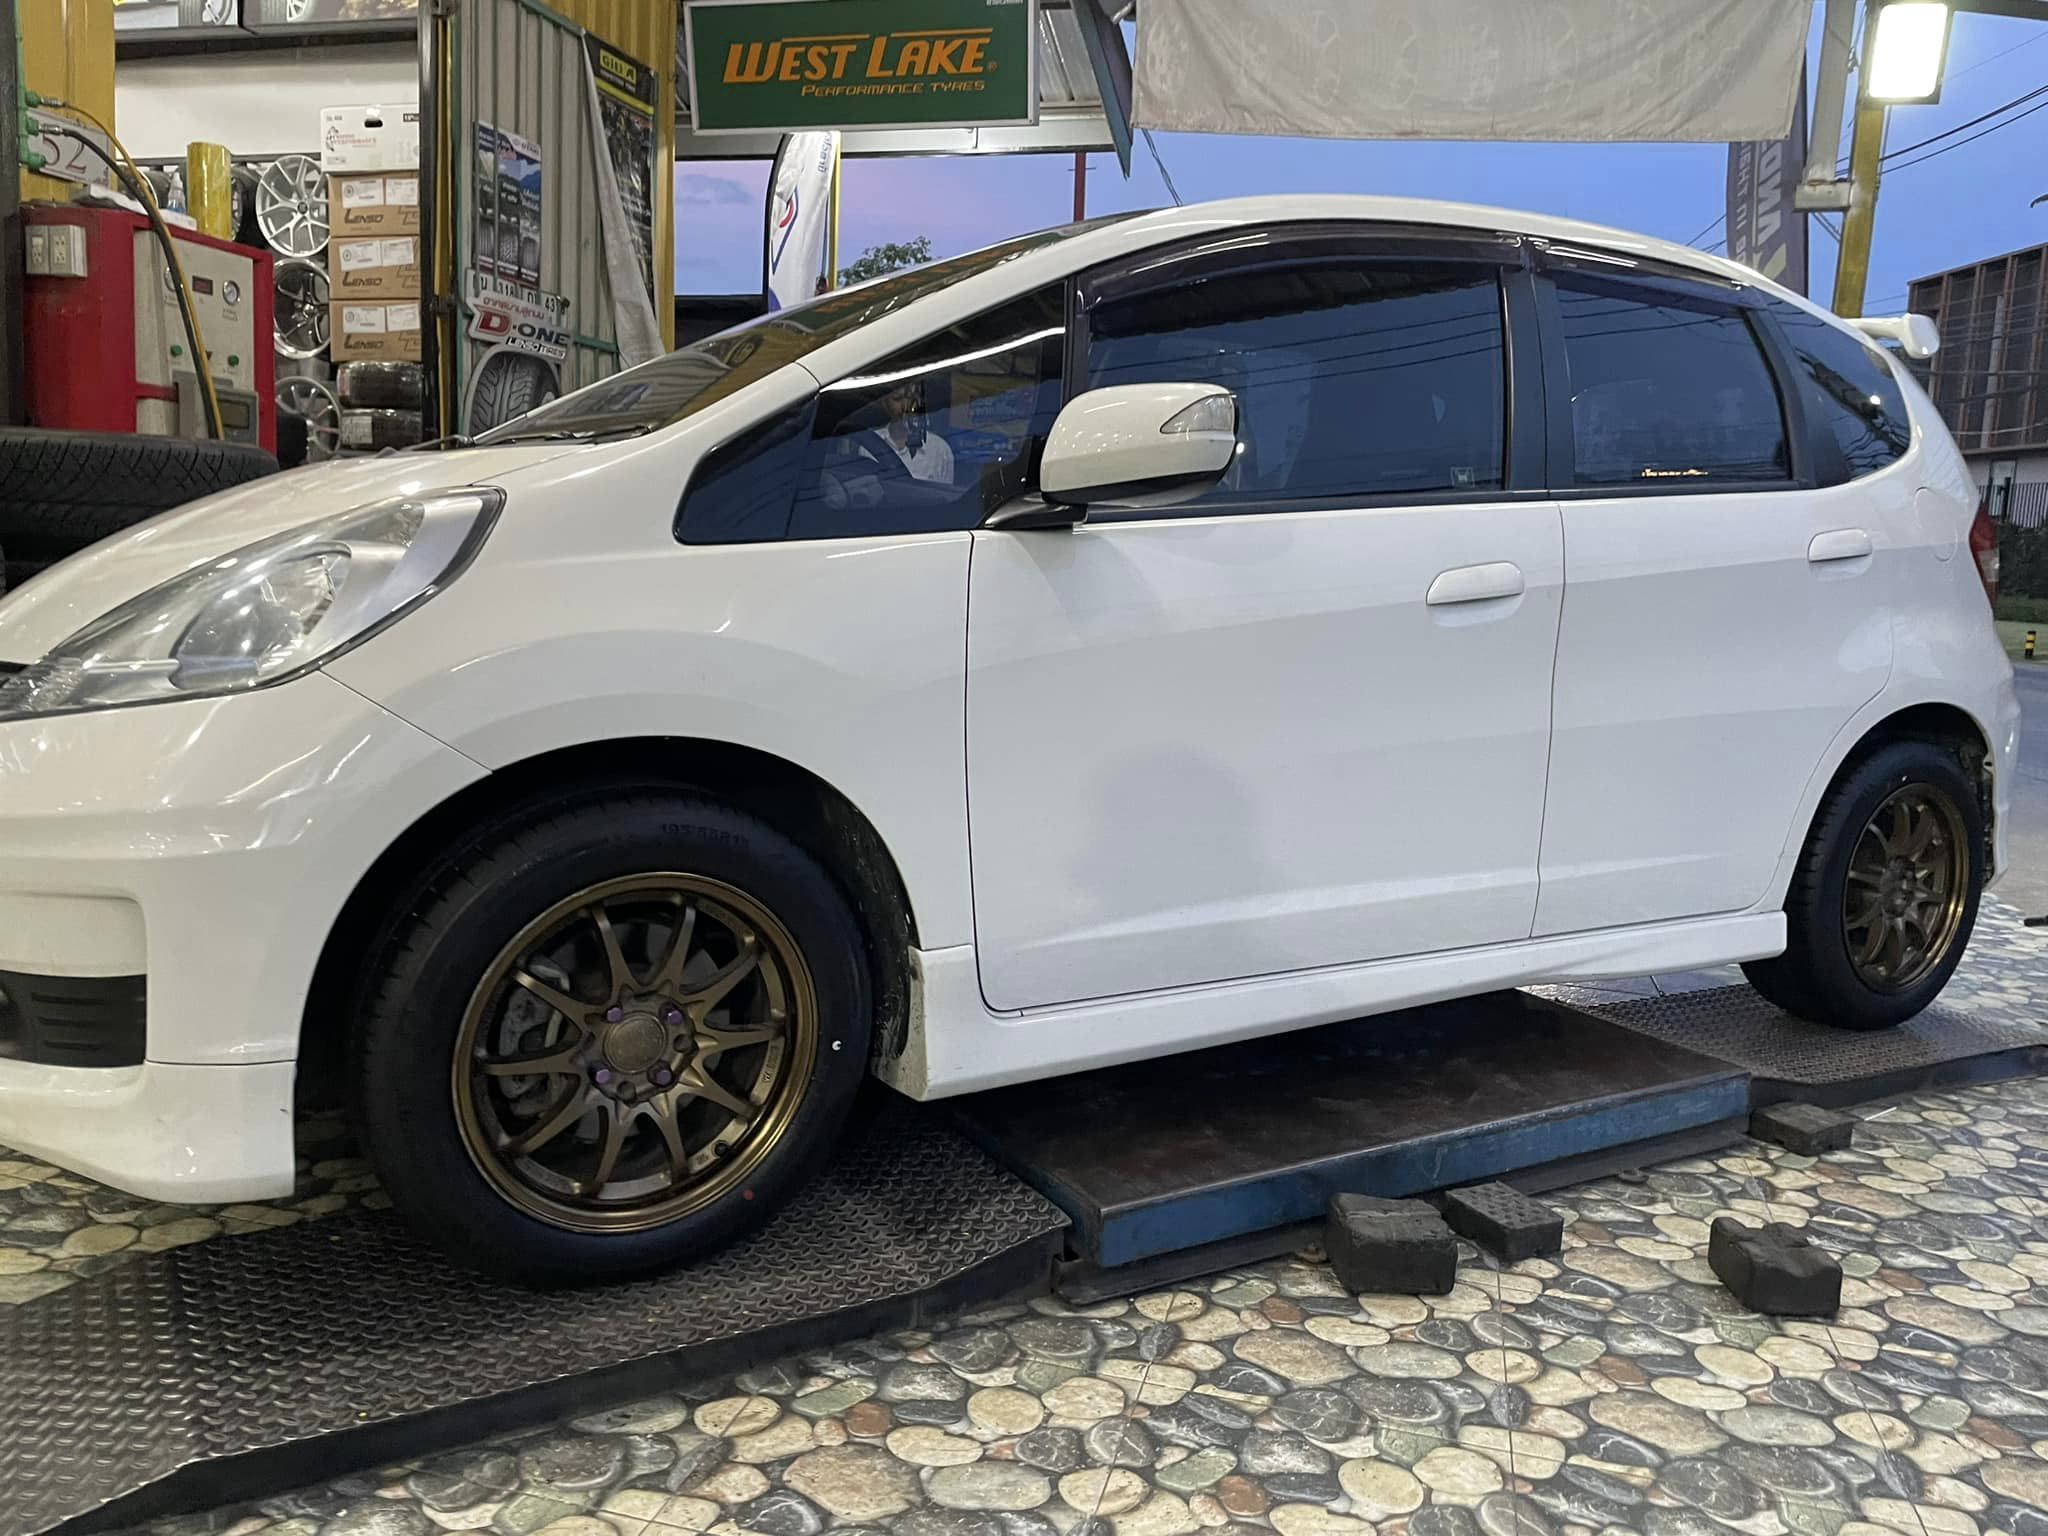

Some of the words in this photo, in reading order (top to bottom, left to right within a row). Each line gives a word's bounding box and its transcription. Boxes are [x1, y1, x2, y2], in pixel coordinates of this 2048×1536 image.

[722, 40, 857, 84] WEST
[866, 36, 991, 78] LAKE
[801, 82, 924, 97] PERFORMANCE
[930, 80, 985, 93] TYRES
[344, 208, 384, 224] LENSO
[342, 271, 383, 287] LENSO
[344, 335, 384, 350] LENSO
